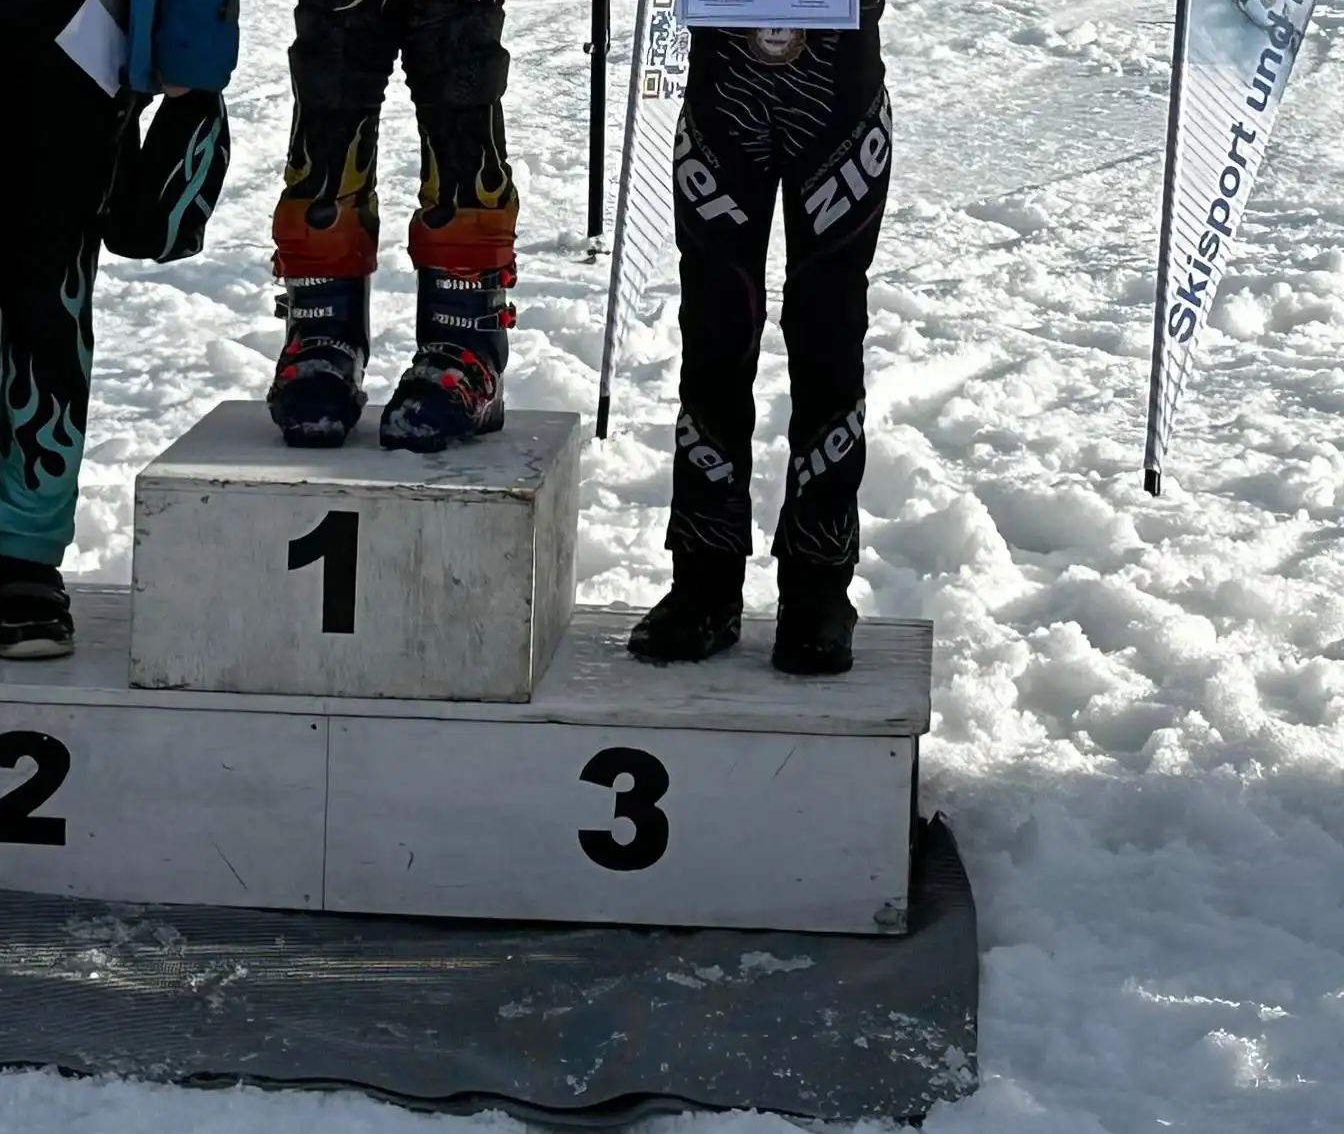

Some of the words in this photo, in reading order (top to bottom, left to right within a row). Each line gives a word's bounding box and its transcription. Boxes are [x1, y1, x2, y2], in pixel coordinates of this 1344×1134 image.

[1168, 121, 1257, 343] Skisport
[1246, 10, 1295, 112] und
[286, 510, 360, 634] 1
[578, 746, 670, 872] 3
